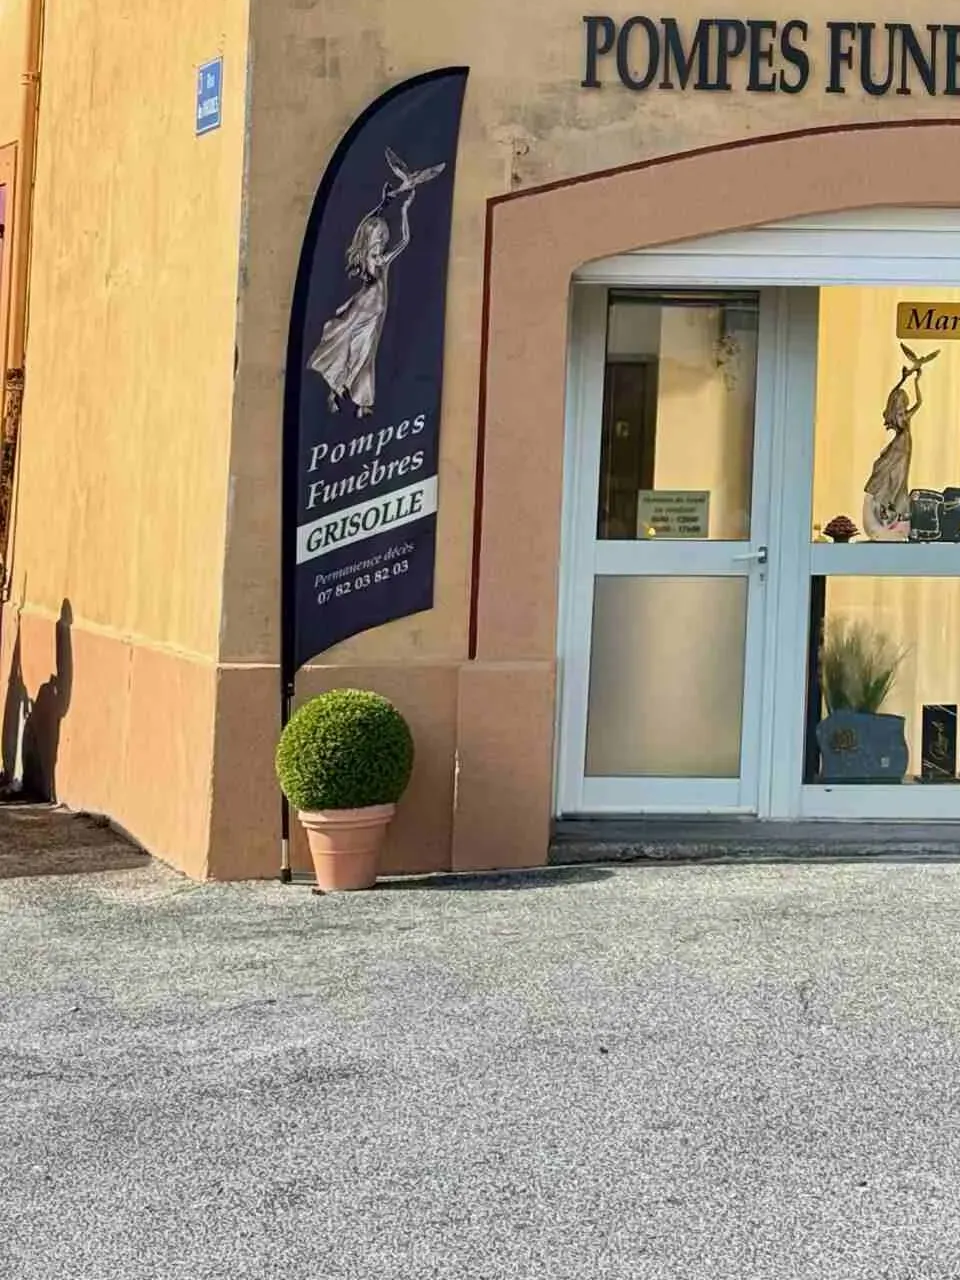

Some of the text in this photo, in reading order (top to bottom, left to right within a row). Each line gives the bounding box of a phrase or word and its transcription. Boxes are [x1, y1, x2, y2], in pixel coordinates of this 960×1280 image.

[581, 14, 810, 94] POMPES
[307, 414, 426, 473] Pompes
[305, 449, 425, 510] Funèbres
[306, 489, 425, 552] GRISOLLE
[317, 560, 409, 605] 07 82 03 82 03
